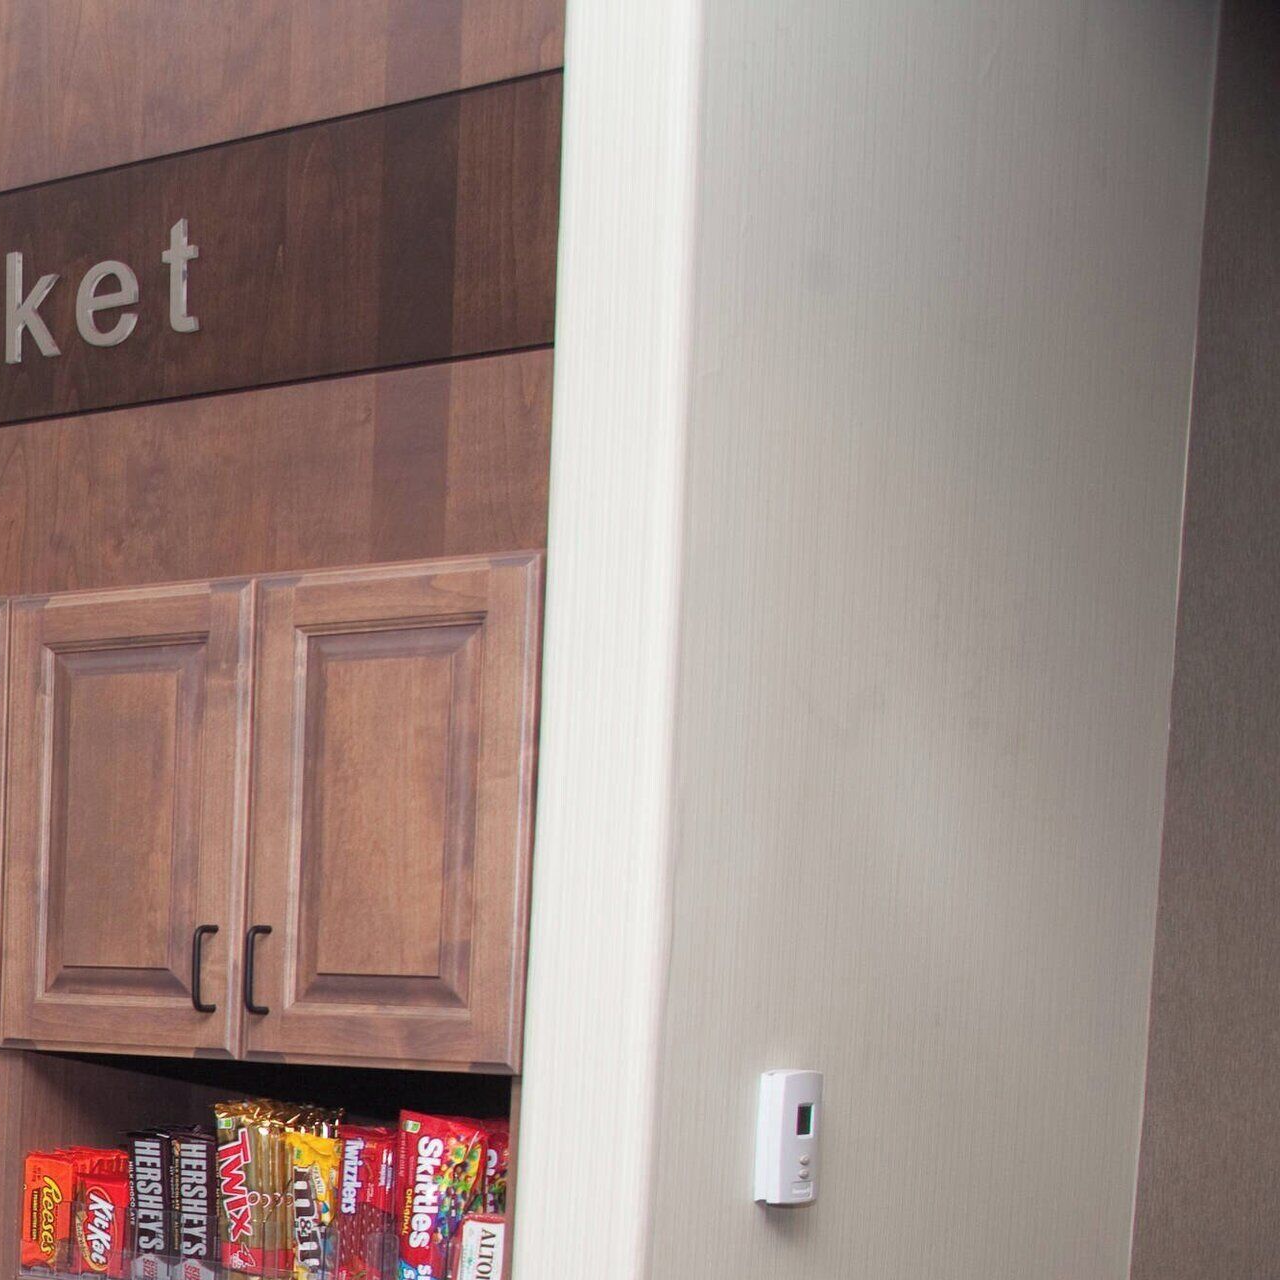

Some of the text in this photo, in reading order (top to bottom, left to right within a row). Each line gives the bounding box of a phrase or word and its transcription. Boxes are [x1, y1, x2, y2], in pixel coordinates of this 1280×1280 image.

[40, 1176, 62, 1254] Reese's
[135, 1141, 164, 1251] HERSHEY'S
[181, 1143, 207, 1257] HERSHEY'S
[217, 1128, 253, 1242] TWIX
[341, 1138, 364, 1215] Twizzlers
[409, 1135, 444, 1249] Skittles
